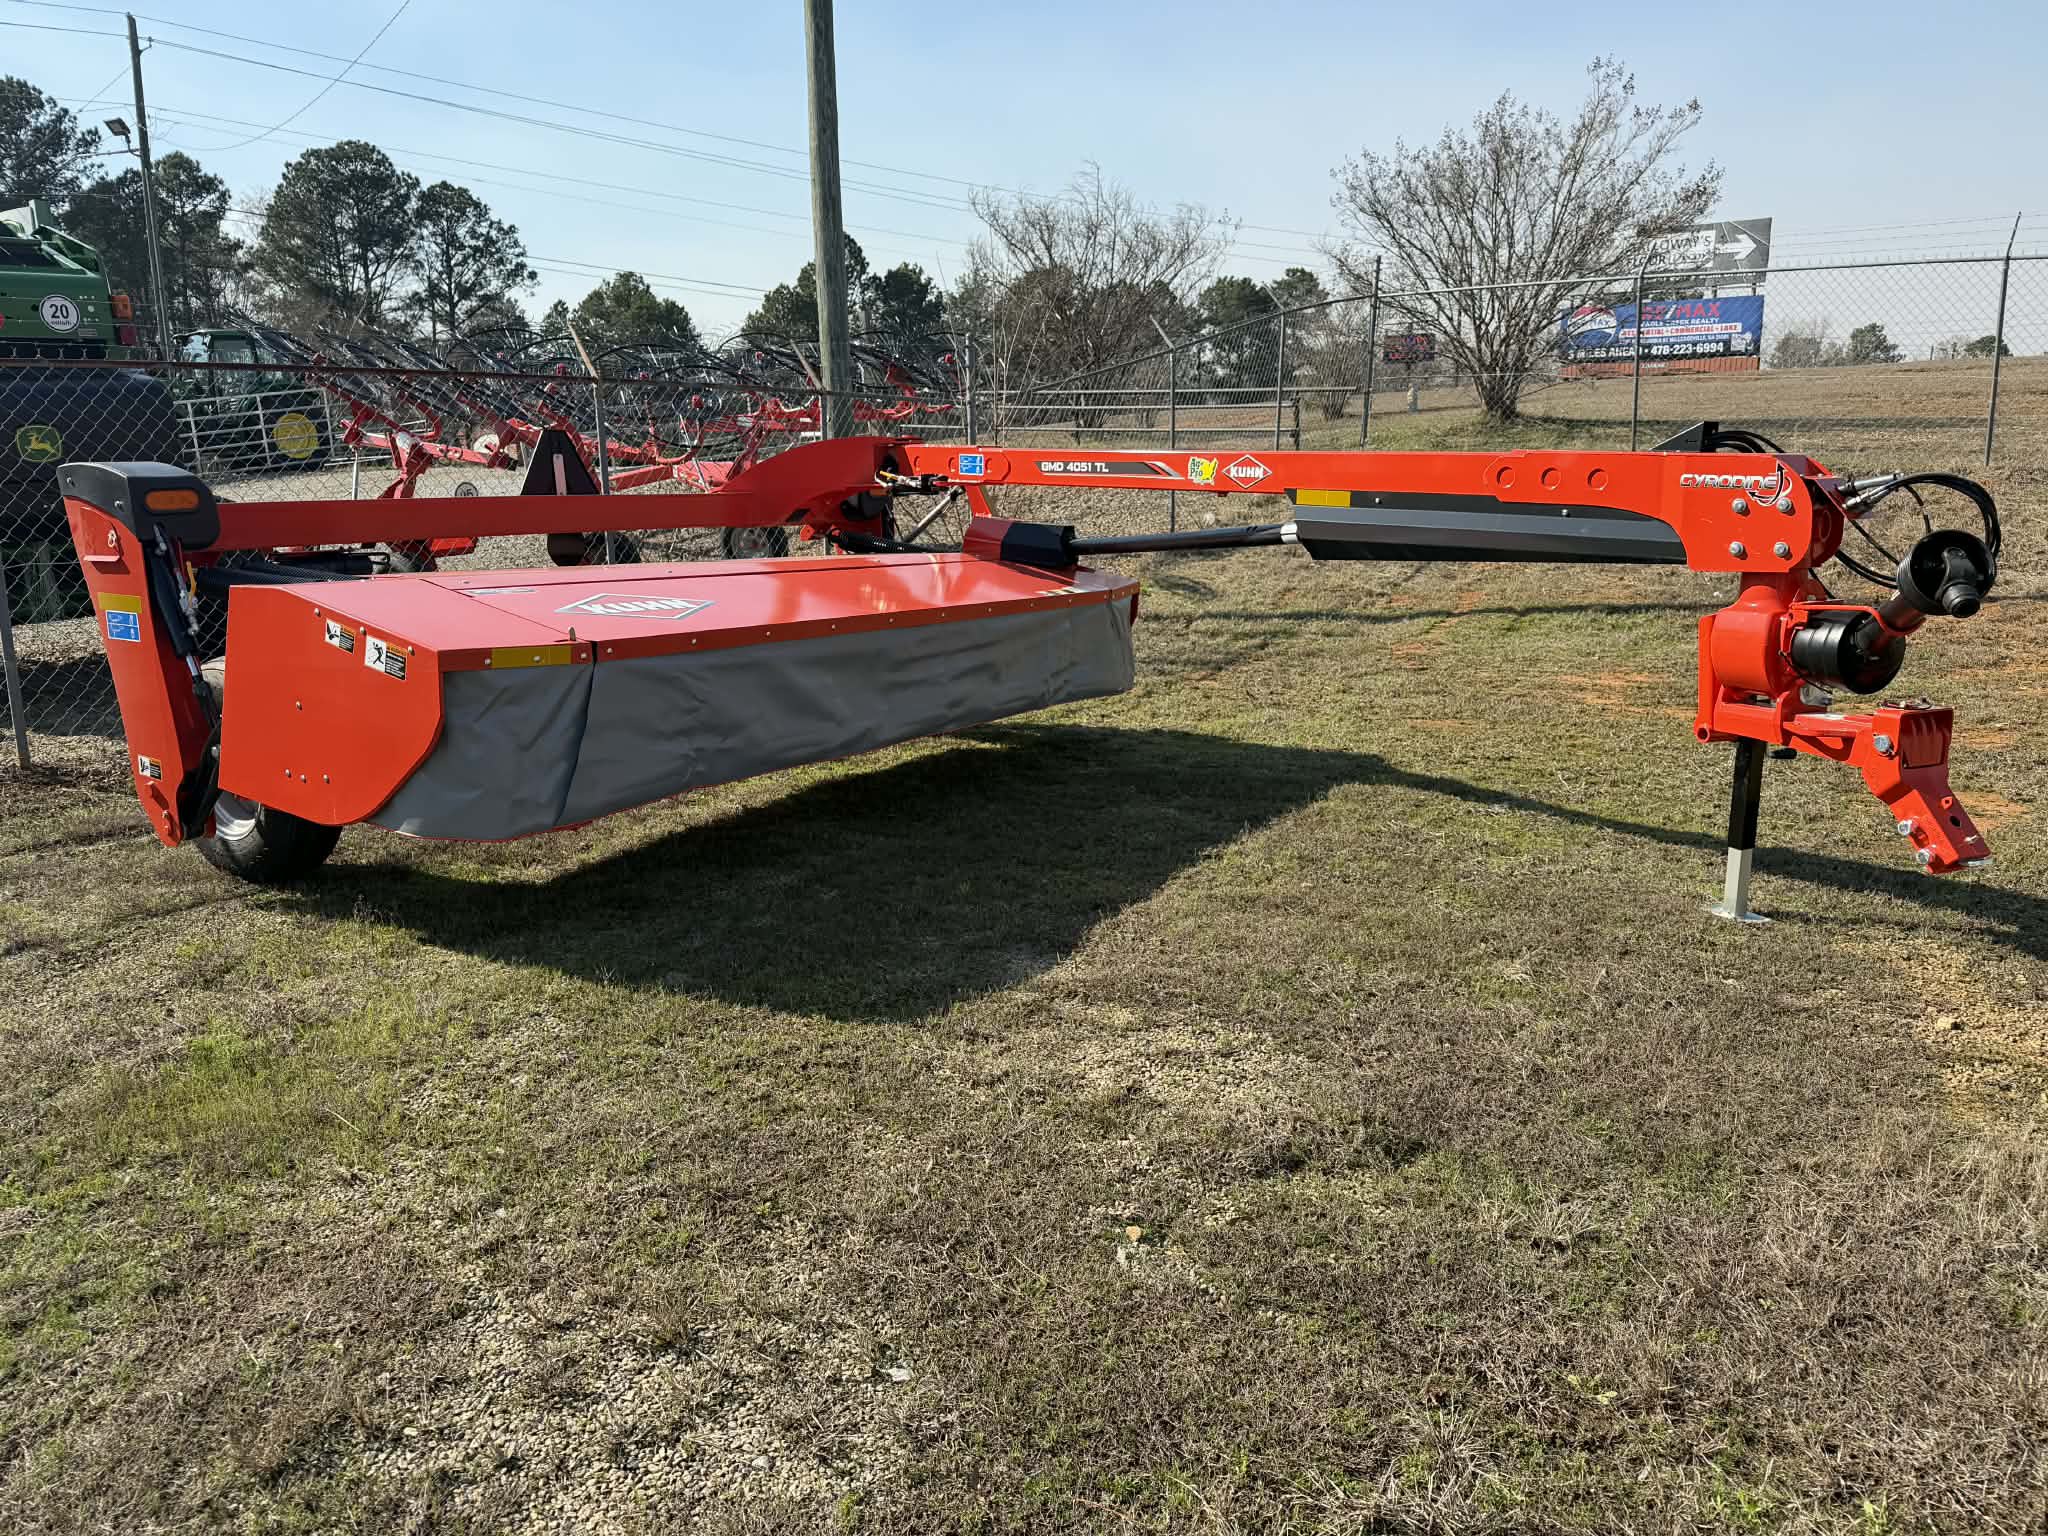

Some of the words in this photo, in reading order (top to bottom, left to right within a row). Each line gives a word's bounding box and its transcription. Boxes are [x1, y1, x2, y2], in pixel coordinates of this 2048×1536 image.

[49, 304, 69, 319] 20
[1690, 317, 1719, 325] REALTY
[1651, 342, 1724, 355] 478-223-6994
[1041, 461, 1064, 472] GMD
[1066, 462, 1092, 472] 4051
[1095, 462, 1109, 472] TL
[1230, 466, 1264, 479] KUHN
[1680, 472, 1777, 489] GYRODINE
[577, 599, 697, 615] KUHN
